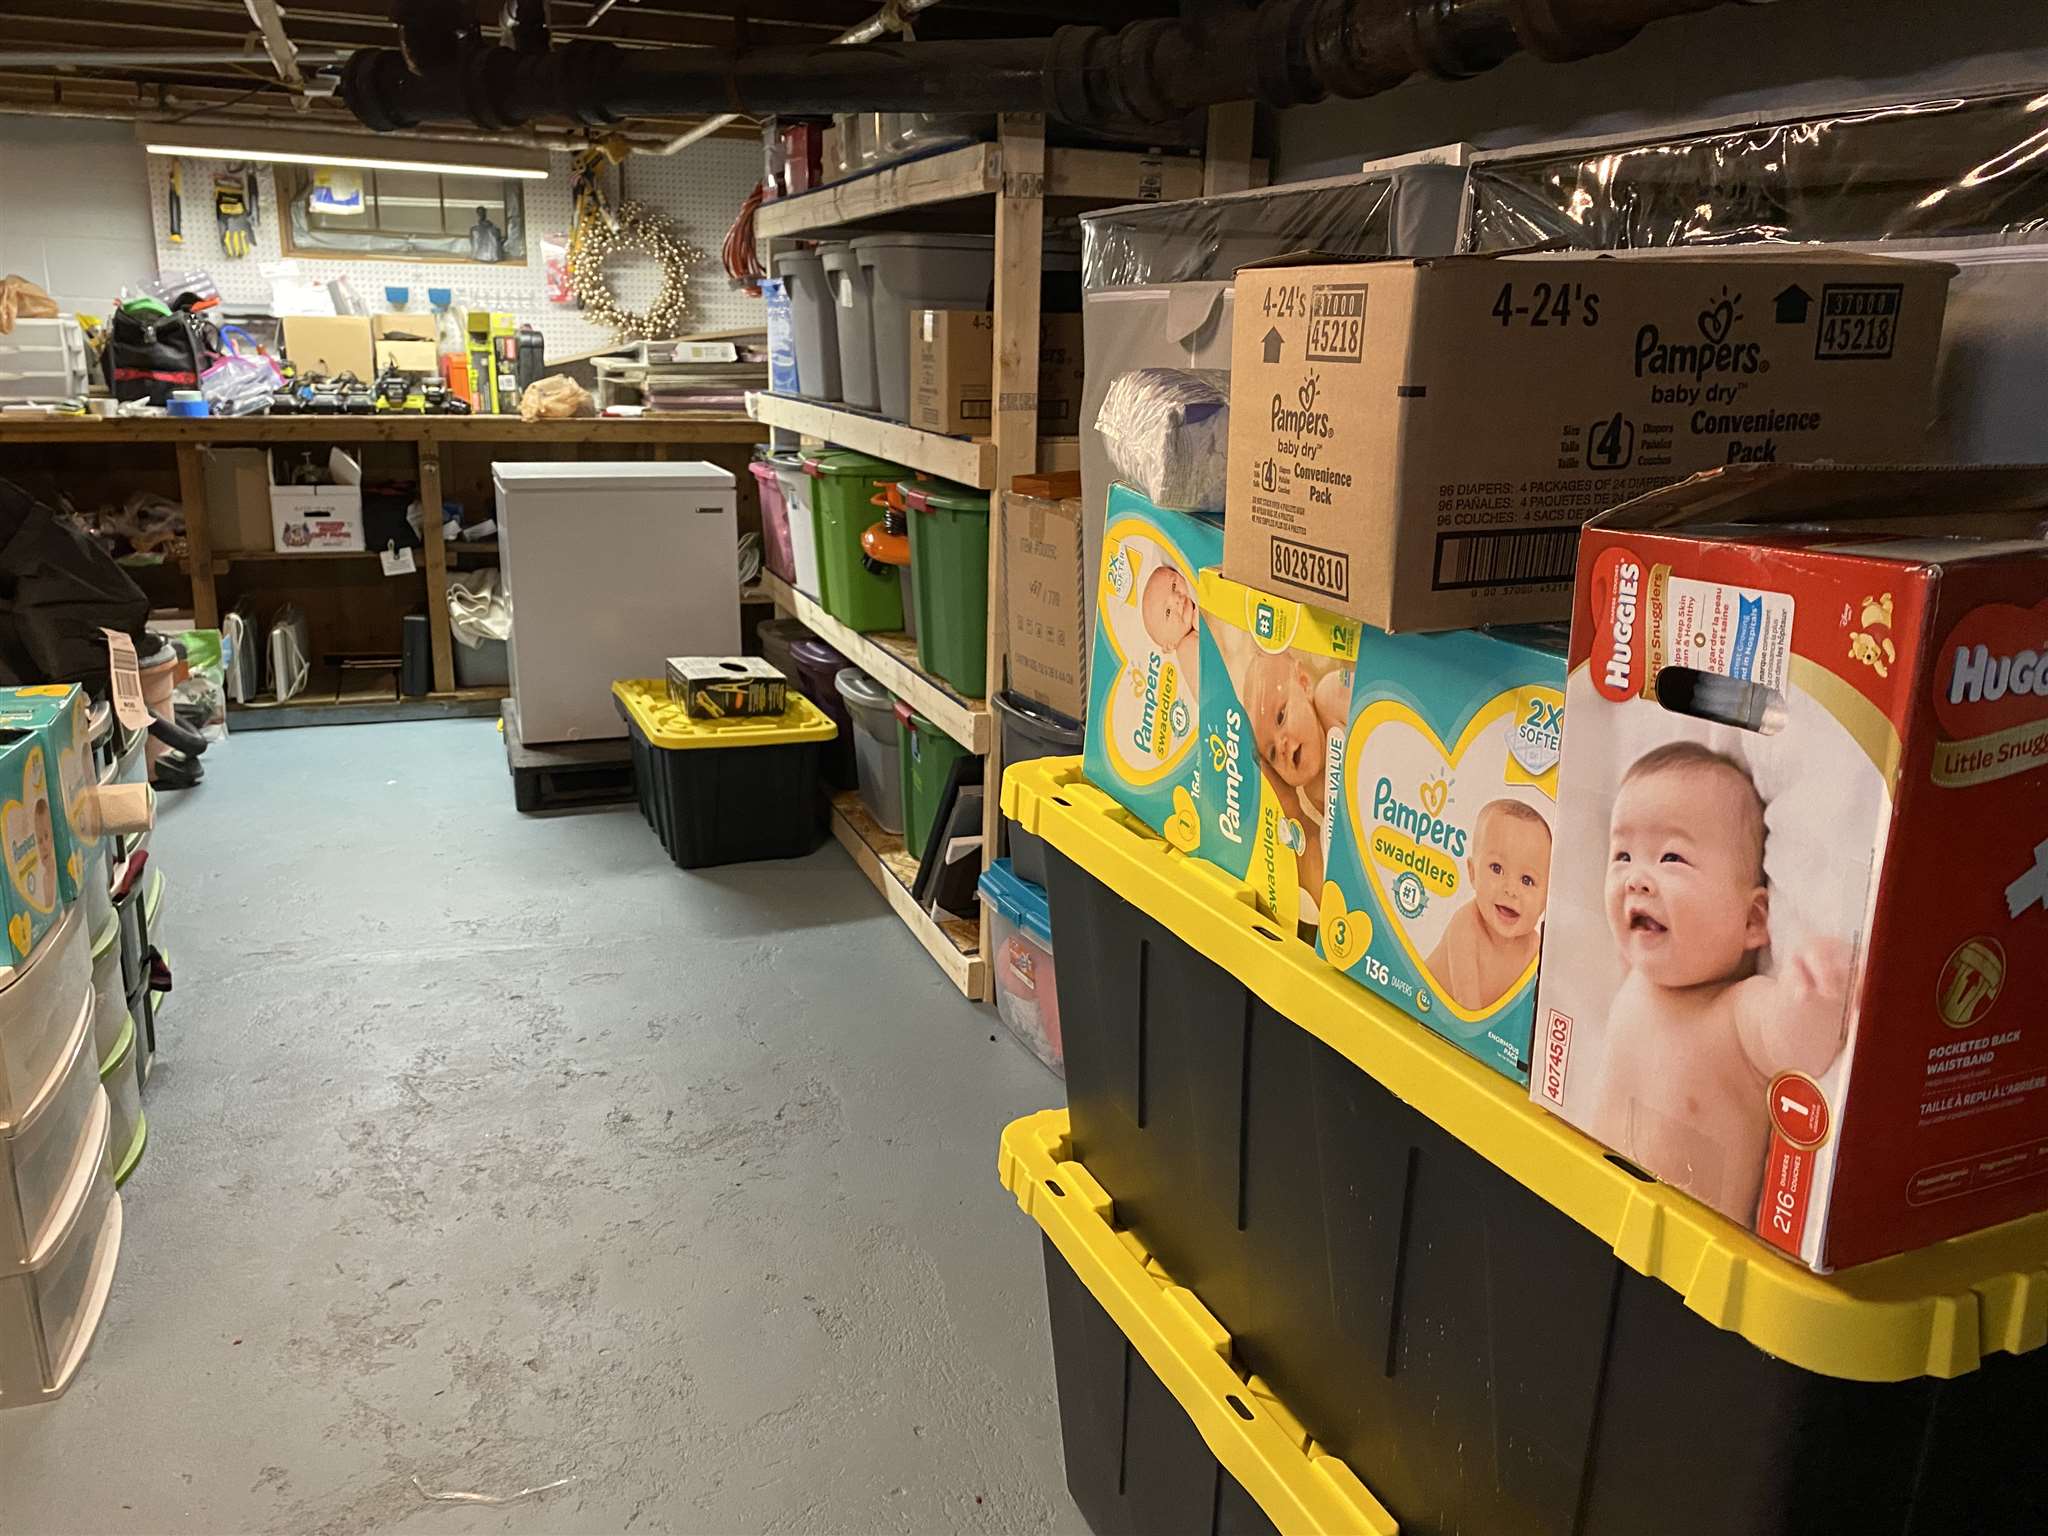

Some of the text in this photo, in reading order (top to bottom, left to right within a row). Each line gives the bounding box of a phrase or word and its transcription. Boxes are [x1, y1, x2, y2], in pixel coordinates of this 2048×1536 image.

[1263, 286, 1306, 318] 4-24's
[1493, 283, 1600, 327] 4-24's
[1311, 319, 1359, 353] 45218
[1823, 318, 1889, 351] 45218
[1635, 324, 1761, 382] Pampers
[1651, 383, 1739, 407] baby dry
[1272, 393, 1329, 440] Pampers
[1690, 409, 1820, 435] Convenience
[1277, 438, 1317, 461] baby dry
[1727, 438, 1777, 464] Pack
[1294, 462, 1352, 487] Convenience
[1457, 482, 1514, 496] DIAPERS:
[1530, 480, 1592, 494] PACKAGES
[1594, 479, 1612, 491] OF
[1309, 485, 1332, 505] Pack
[1527, 494, 1591, 508] PAQUETES
[1594, 494, 1610, 506] DE
[1455, 511, 1518, 526] COUCHES:
[1534, 509, 1565, 523] SACS
[1567, 508, 1583, 521] DE
[1275, 543, 1344, 591] 80287810
[1258, 608, 1272, 634] #1
[1604, 563, 1640, 690] HUGGIES
[1651, 572, 1663, 648] Snugglers
[1686, 597, 1696, 637] Healthy
[1333, 624, 1346, 652] 12
[1744, 607, 1757, 655] Hospitals
[1133, 651, 1161, 754] Pampers
[1157, 666, 1175, 755] swaddlers
[1527, 699, 1564, 734] 2X
[1520, 725, 1560, 751] SOFTE
[1219, 708, 1242, 844] Pampers
[1329, 737, 1343, 791] VALUE
[1944, 749, 1994, 774] Little
[1373, 777, 1467, 858] Pampers
[1264, 807, 1278, 914] swaddlers
[1374, 837, 1455, 889] swaddlers
[1402, 885, 1417, 904] #1
[1335, 920, 1346, 945] 3
[1365, 954, 1413, 997] 136 DIAPERS
[1928, 1029, 2022, 1061] POCKETED BACK
[1927, 1051, 1995, 1075] WAISTBAND
[1780, 1095, 1809, 1116] 1
[1919, 1098, 1954, 1116] TAILLE
[1780, 1154, 1790, 1188] DIAPERS
[1790, 1155, 1801, 1193] COUCHES
[1773, 1190, 1795, 1235] 216
